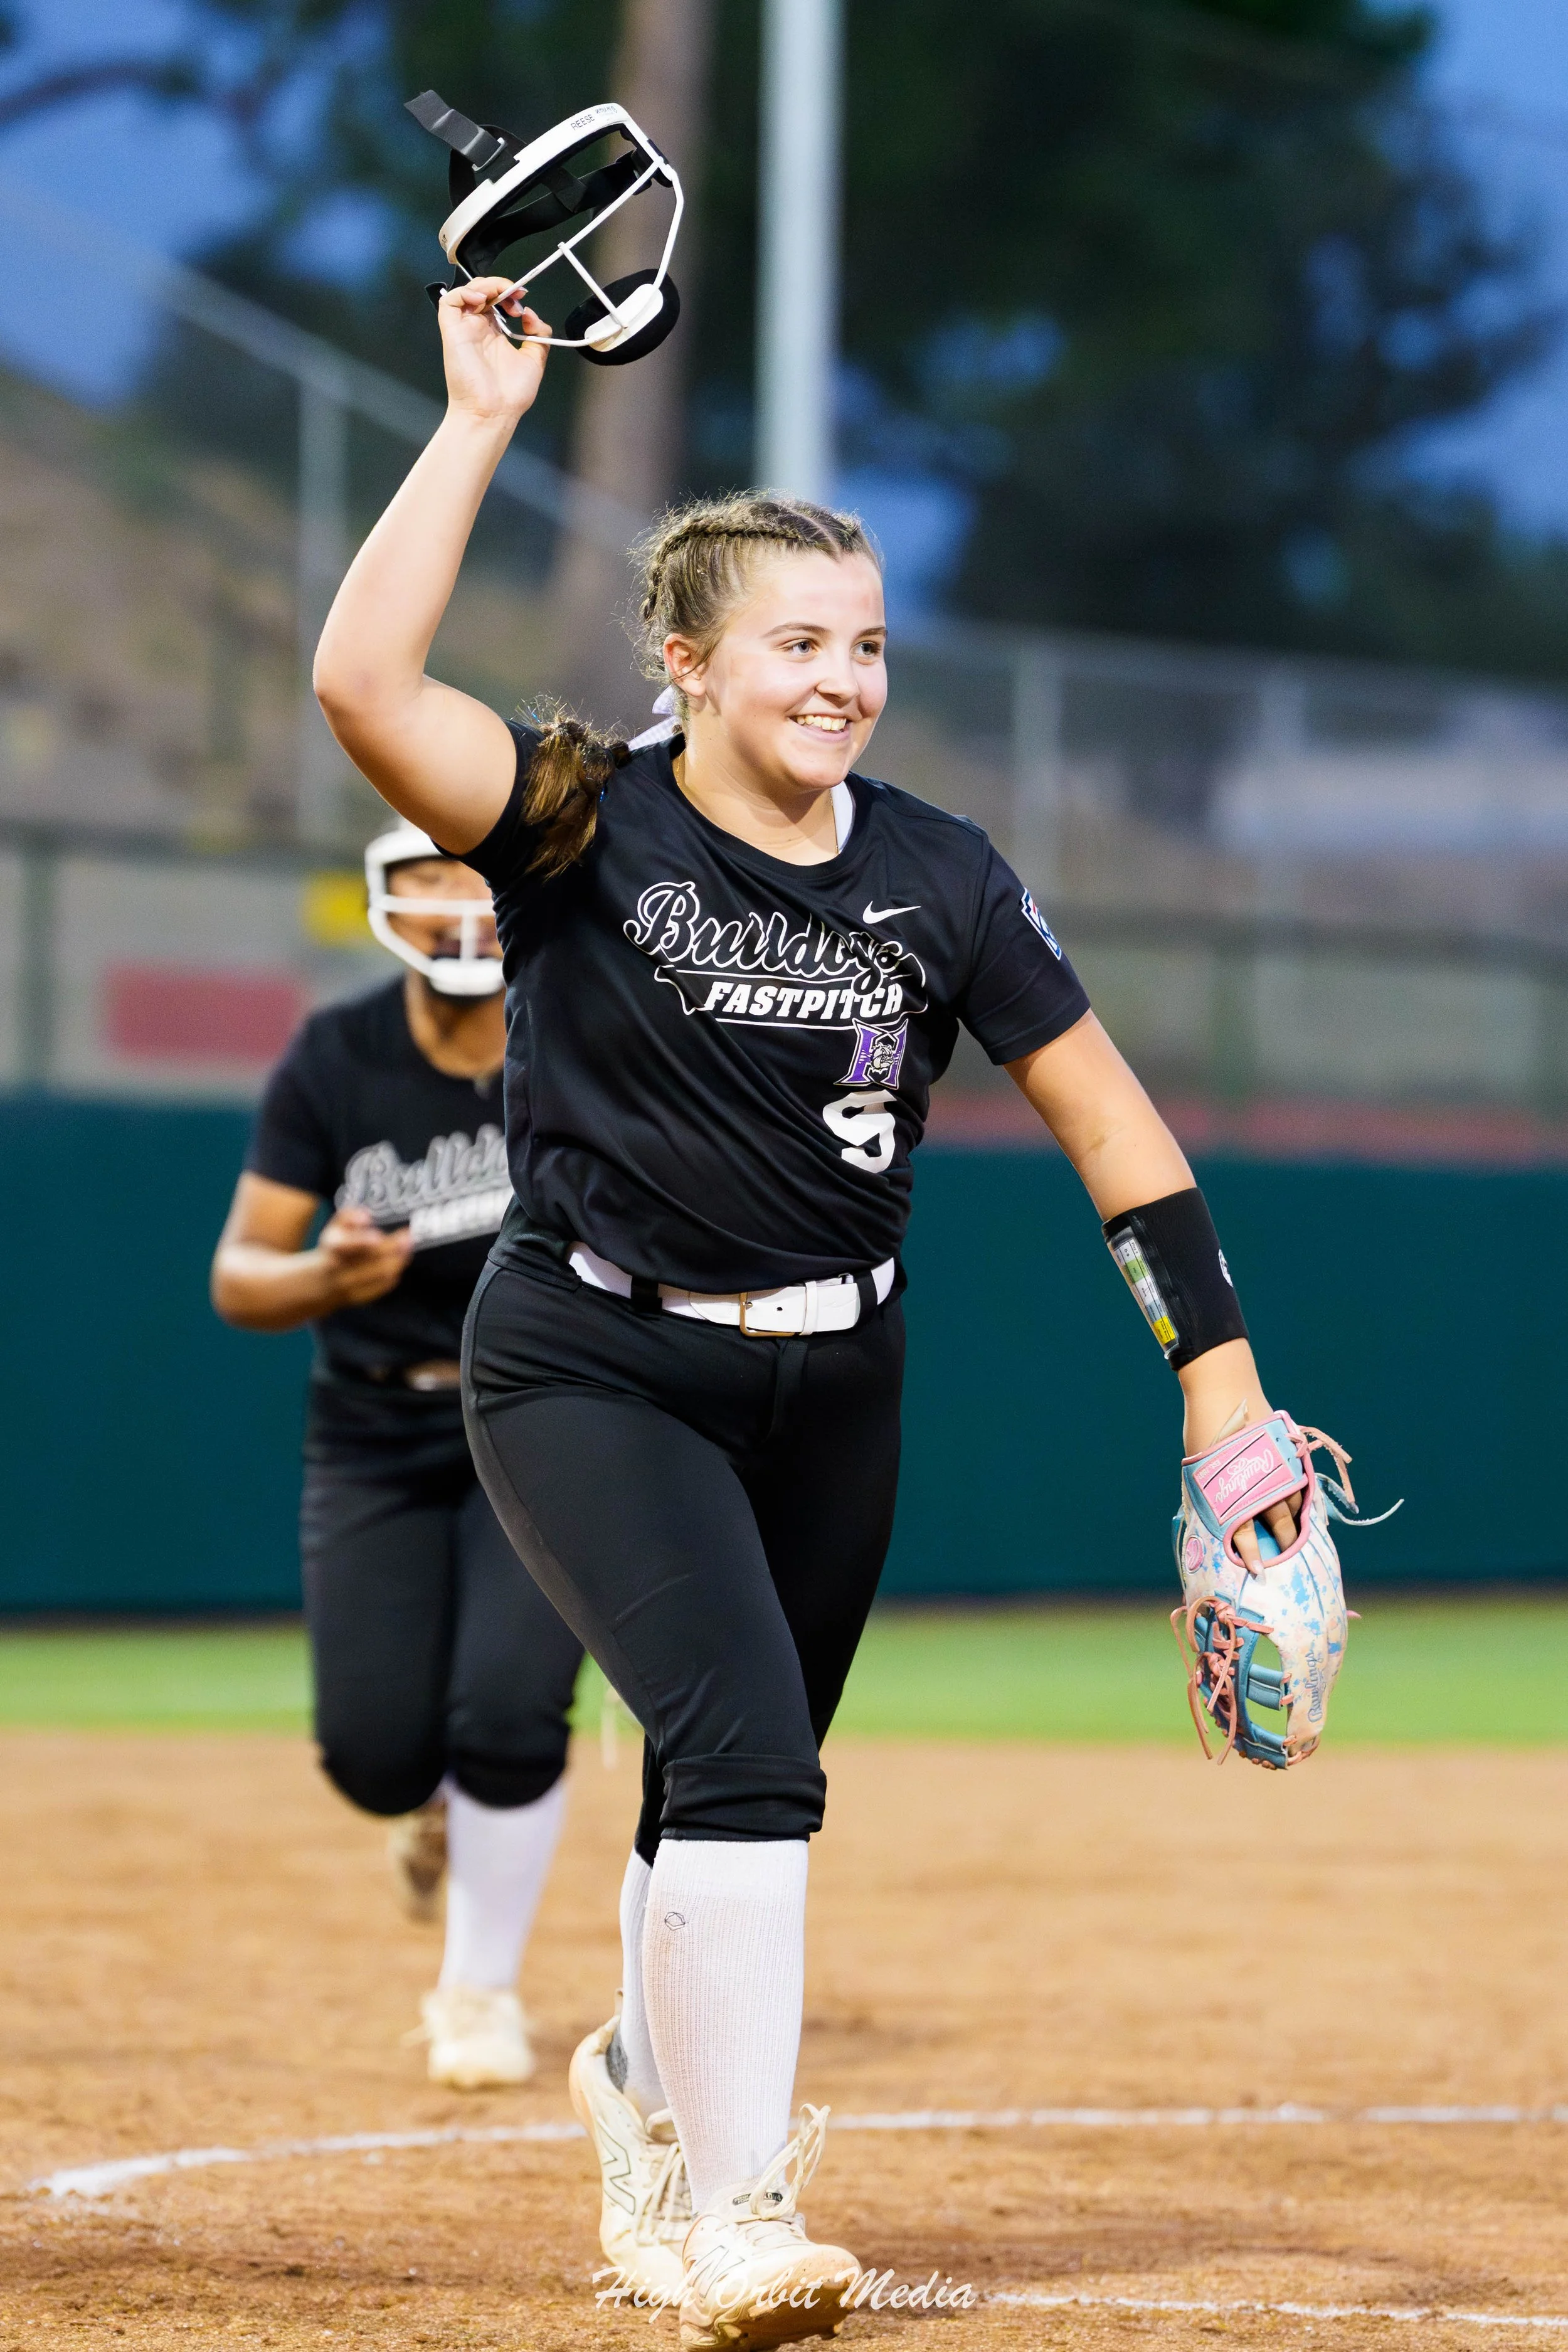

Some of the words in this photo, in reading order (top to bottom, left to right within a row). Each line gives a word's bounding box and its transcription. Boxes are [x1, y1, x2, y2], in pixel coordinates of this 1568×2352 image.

[569, 114, 595, 131] REESE
[703, 981, 903, 1020] FASTPITCH
[1214, 1448, 1274, 1503] Rawlings
[1305, 1652, 1324, 1722] Rawlings
